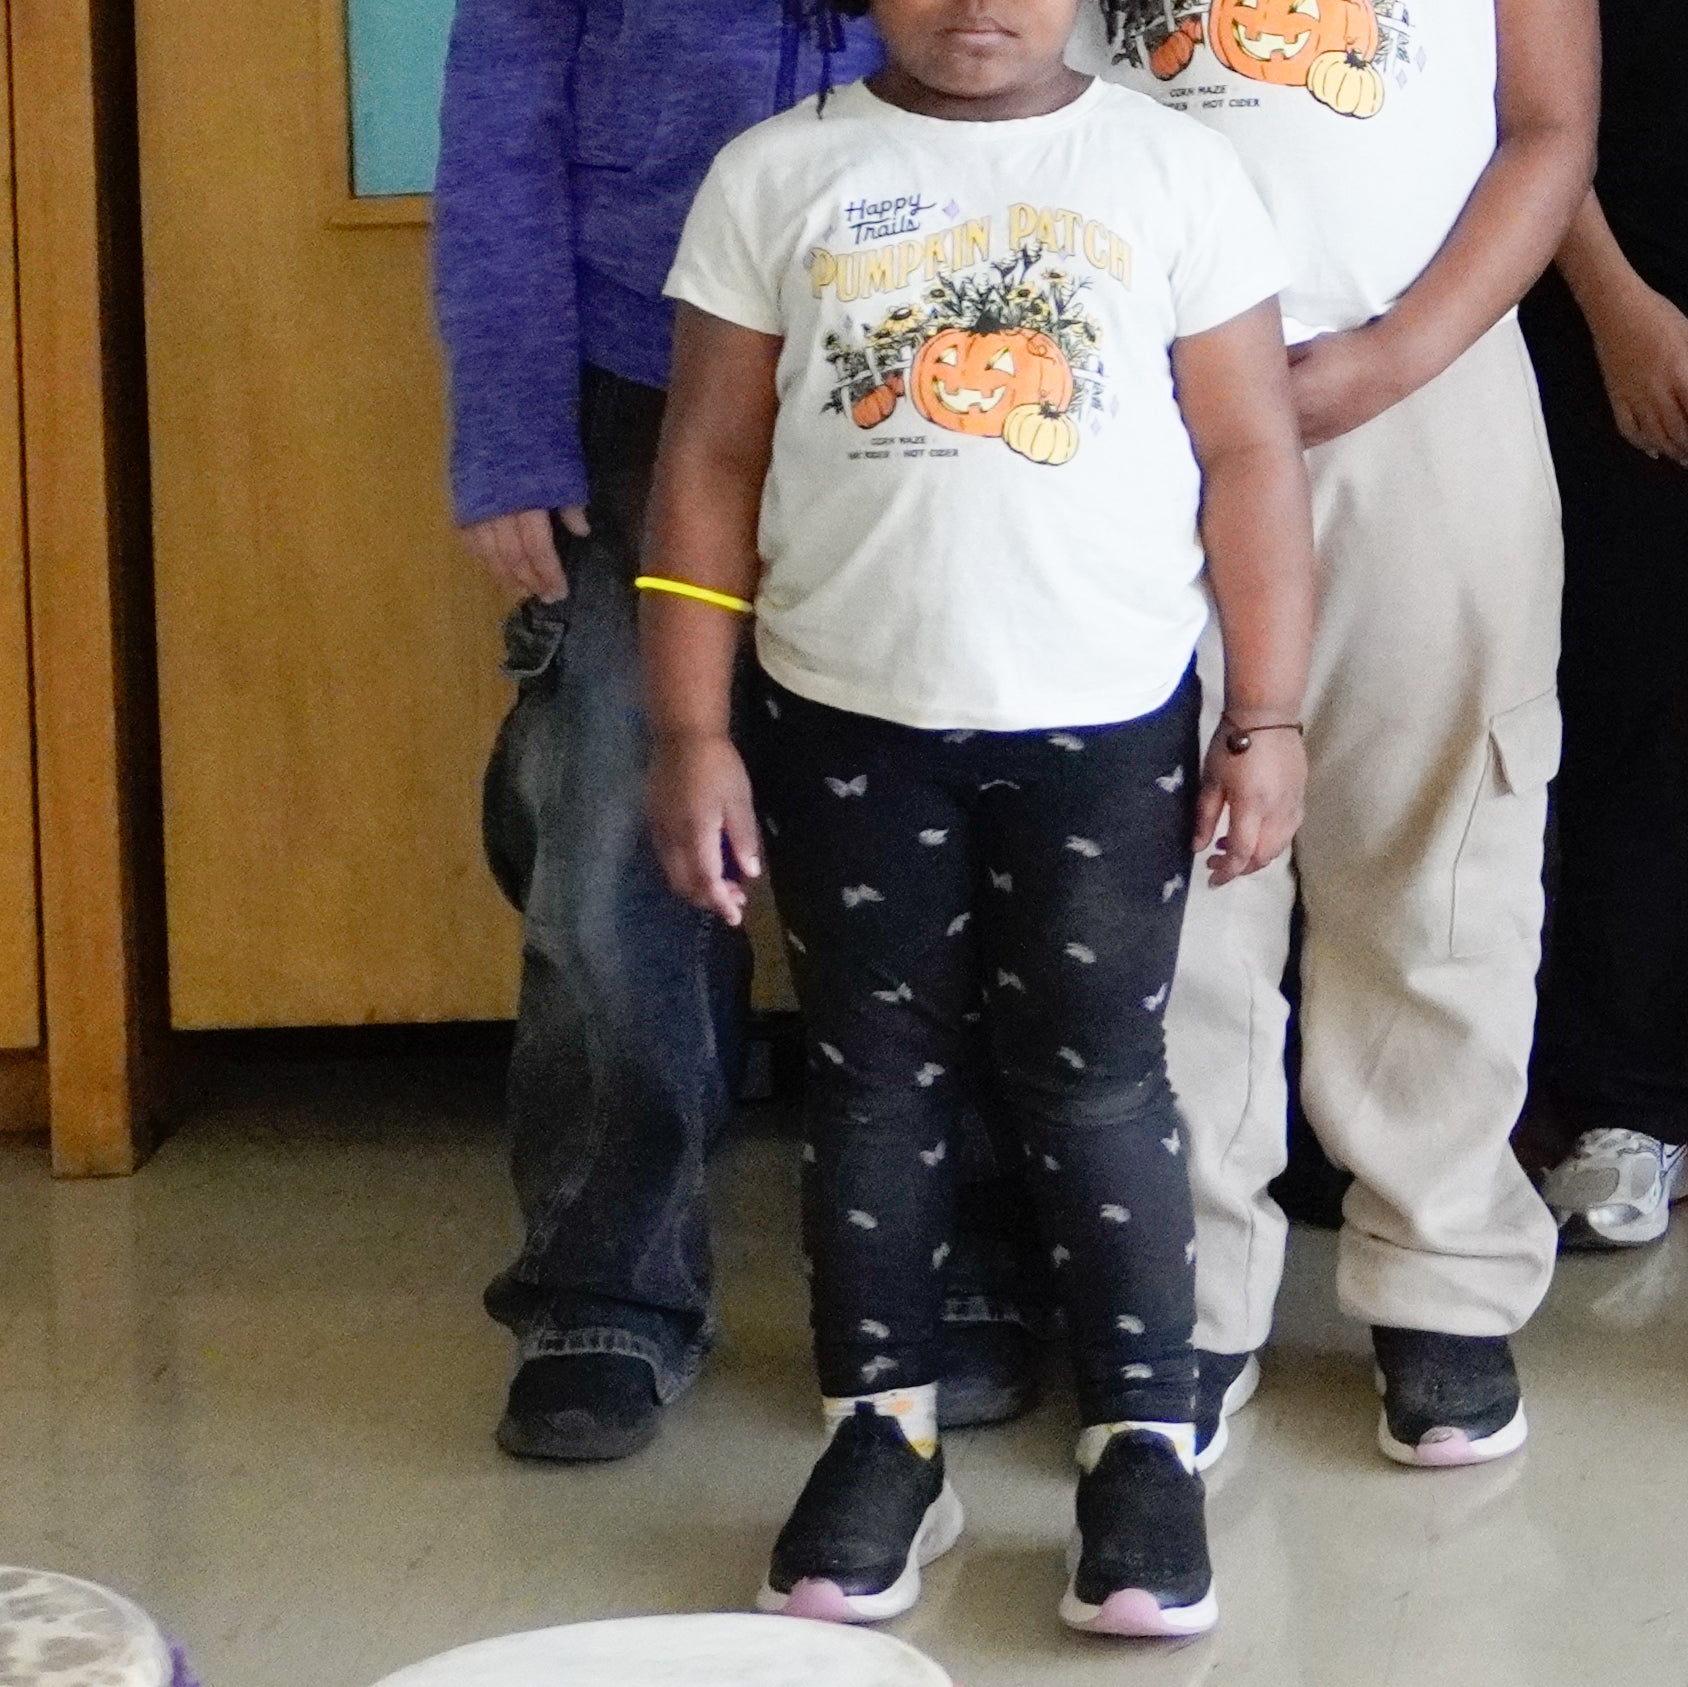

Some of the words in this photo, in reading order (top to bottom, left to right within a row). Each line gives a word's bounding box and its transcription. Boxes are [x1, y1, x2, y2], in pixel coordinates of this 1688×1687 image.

[845, 192, 936, 222] Happy
[850, 218, 920, 245] Trails
[803, 215, 992, 303] PUMPKIN
[1007, 202, 1133, 292] PATCH
